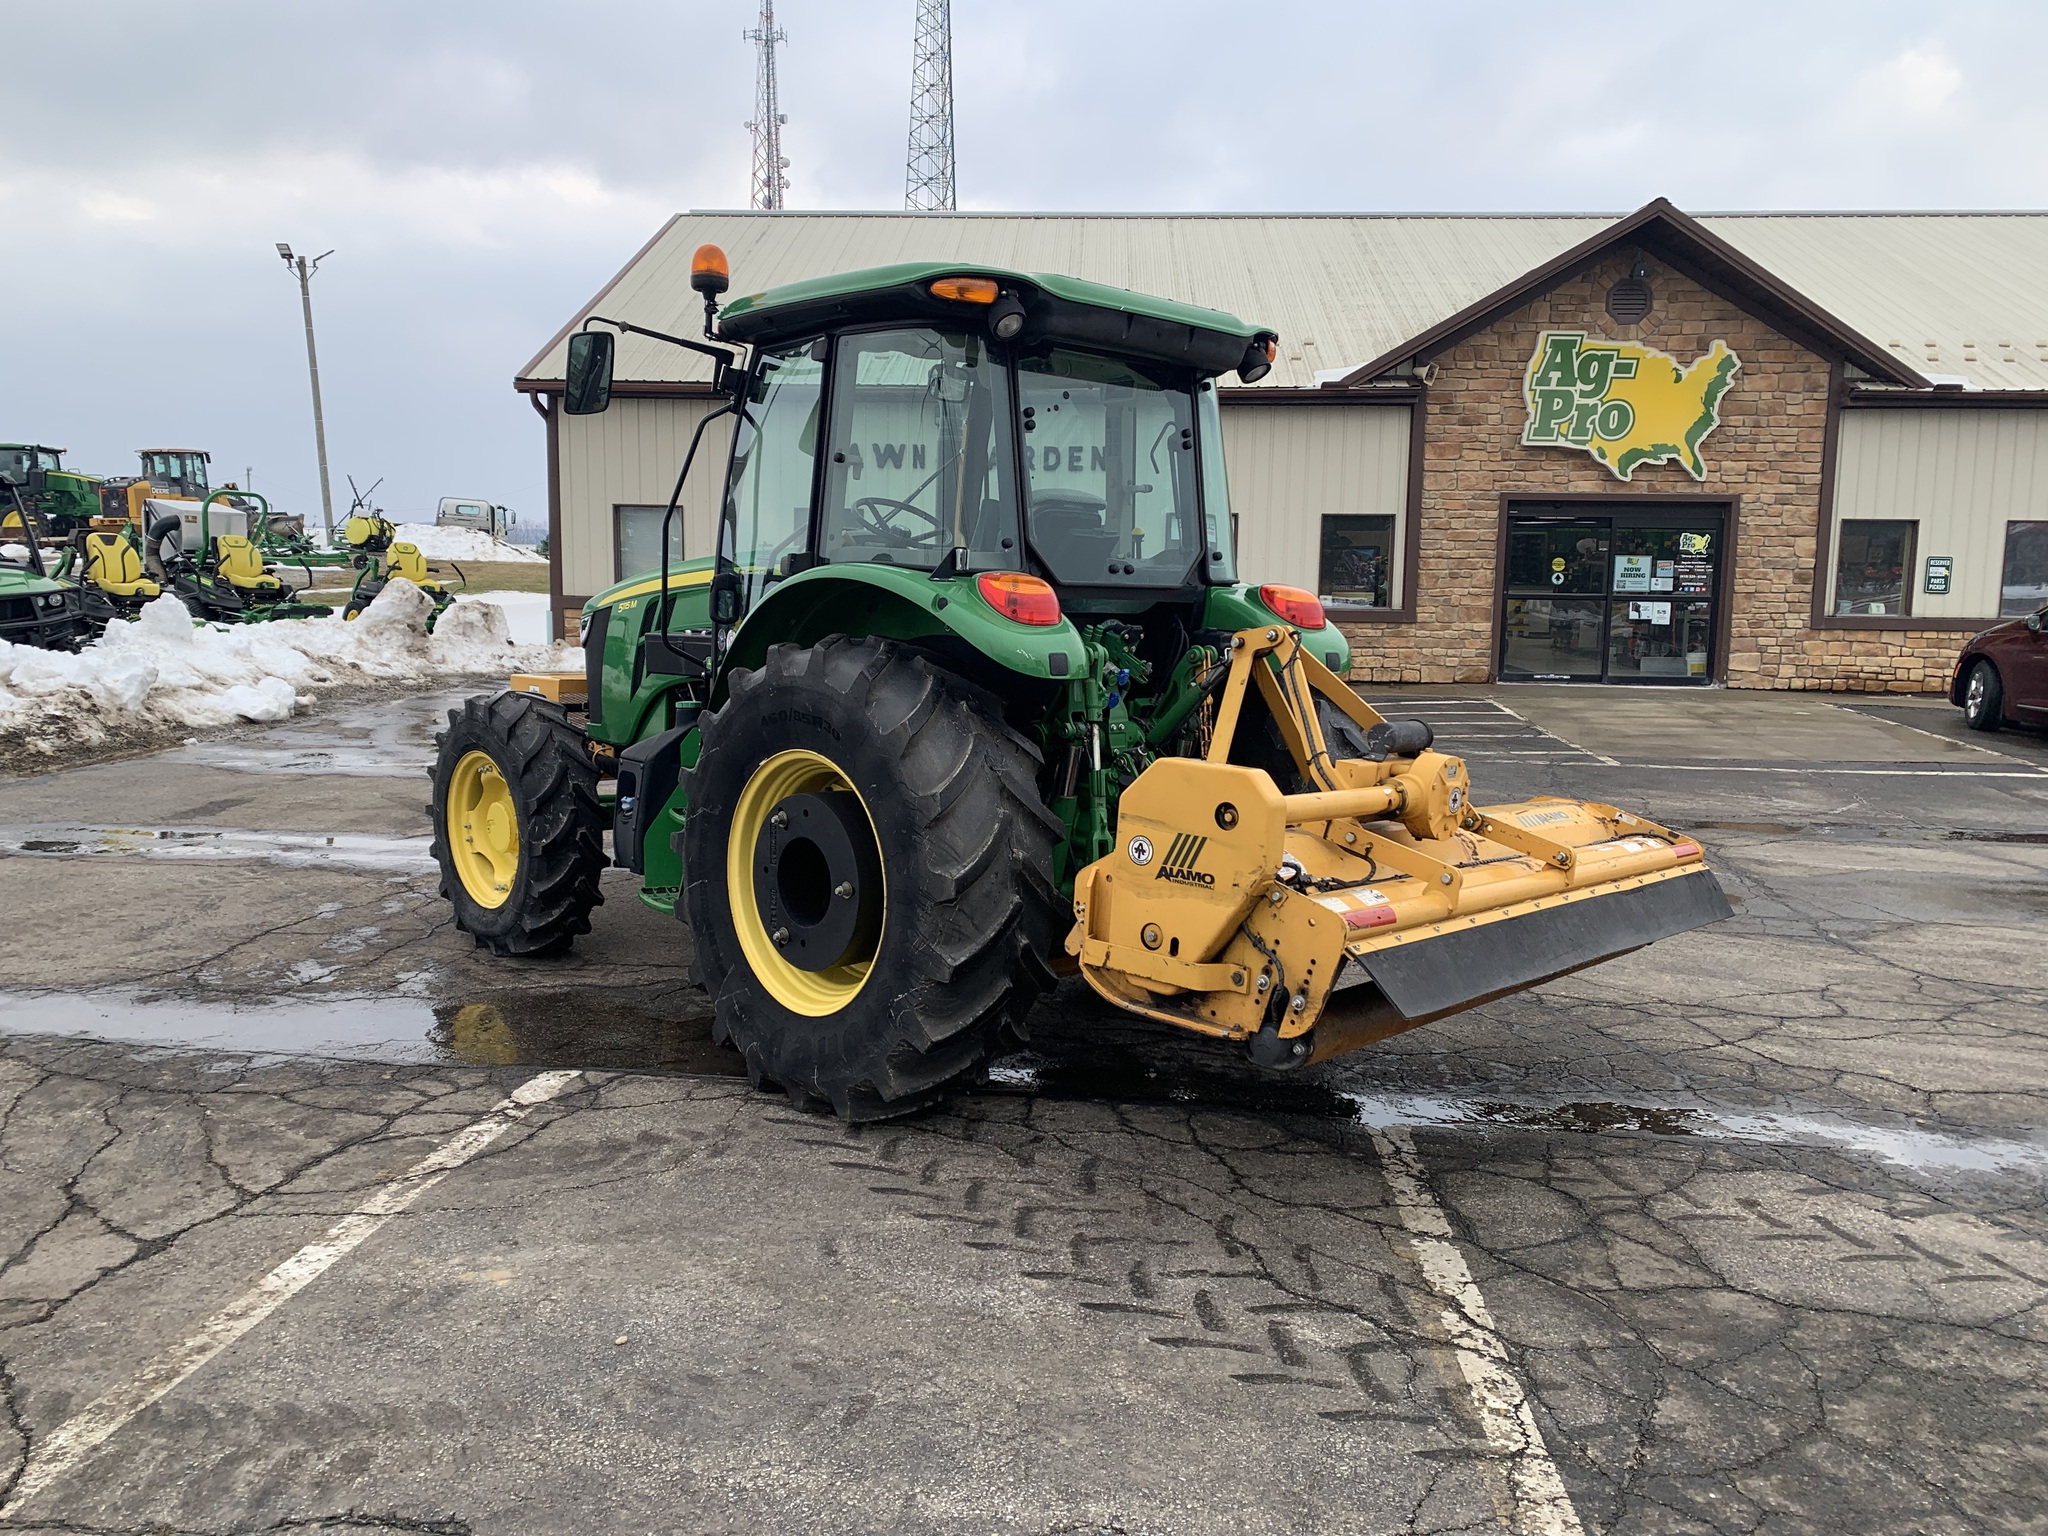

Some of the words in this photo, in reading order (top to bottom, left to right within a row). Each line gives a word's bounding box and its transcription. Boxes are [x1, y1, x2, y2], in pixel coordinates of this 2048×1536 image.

[1530, 334, 1640, 401] Ag-
[1526, 387, 1636, 443] Pro
[849, 442, 926, 470] AWN
[1682, 541, 1696, 549] Pro
[1535, 811, 1570, 825] ALAMO
[1155, 865, 1216, 886] ALAMO
[1171, 878, 1216, 890] INDUSTRIAL
